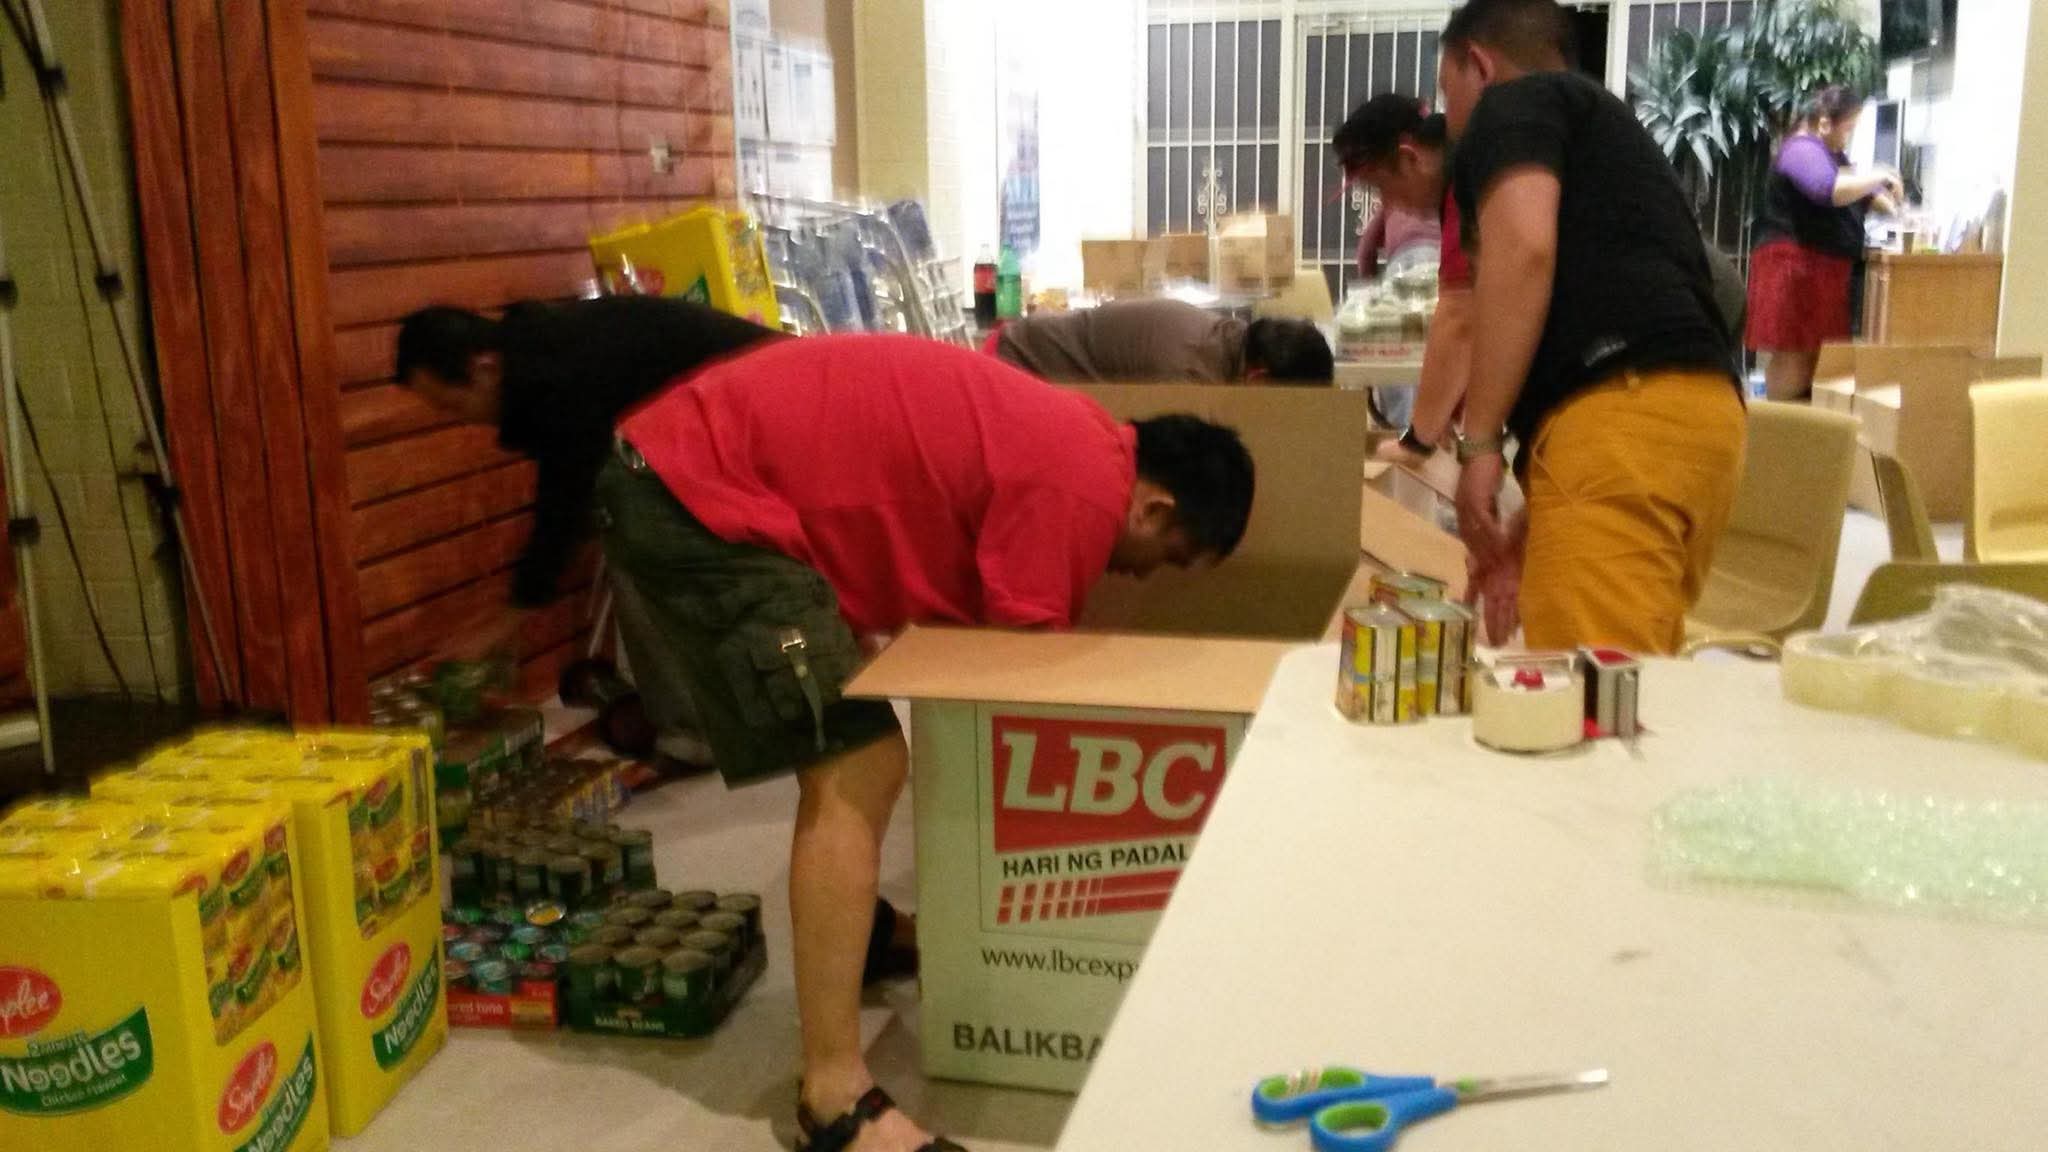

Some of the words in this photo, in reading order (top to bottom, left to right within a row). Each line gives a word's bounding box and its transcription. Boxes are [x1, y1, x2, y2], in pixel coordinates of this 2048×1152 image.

[1001, 731, 1217, 821] LBC
[1002, 854, 1060, 879] HARI
[1067, 851, 1103, 872] NG
[1, 1030, 142, 1093] Noodles
